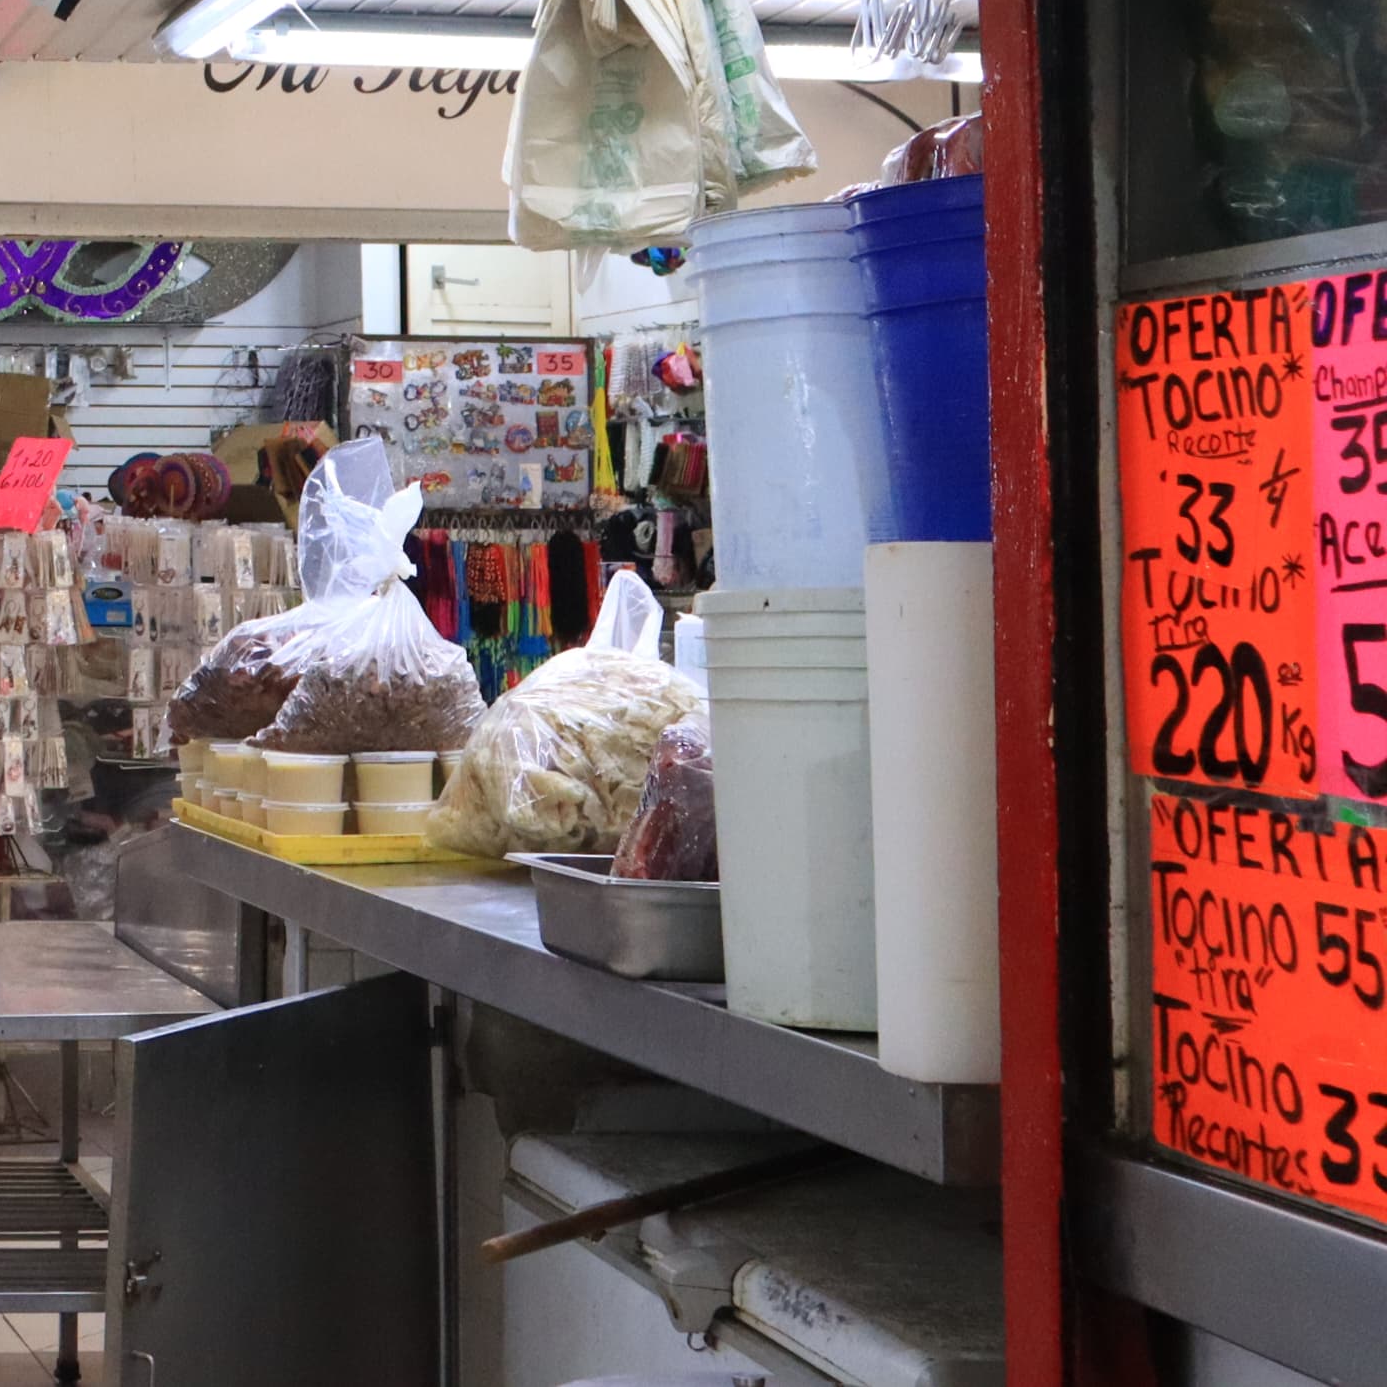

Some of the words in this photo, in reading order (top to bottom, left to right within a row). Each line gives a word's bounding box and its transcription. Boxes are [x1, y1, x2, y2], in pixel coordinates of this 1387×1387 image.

[363, 364, 393, 380] 30
[545, 354, 573, 372] 35
[1150, 641, 1273, 787] 220
